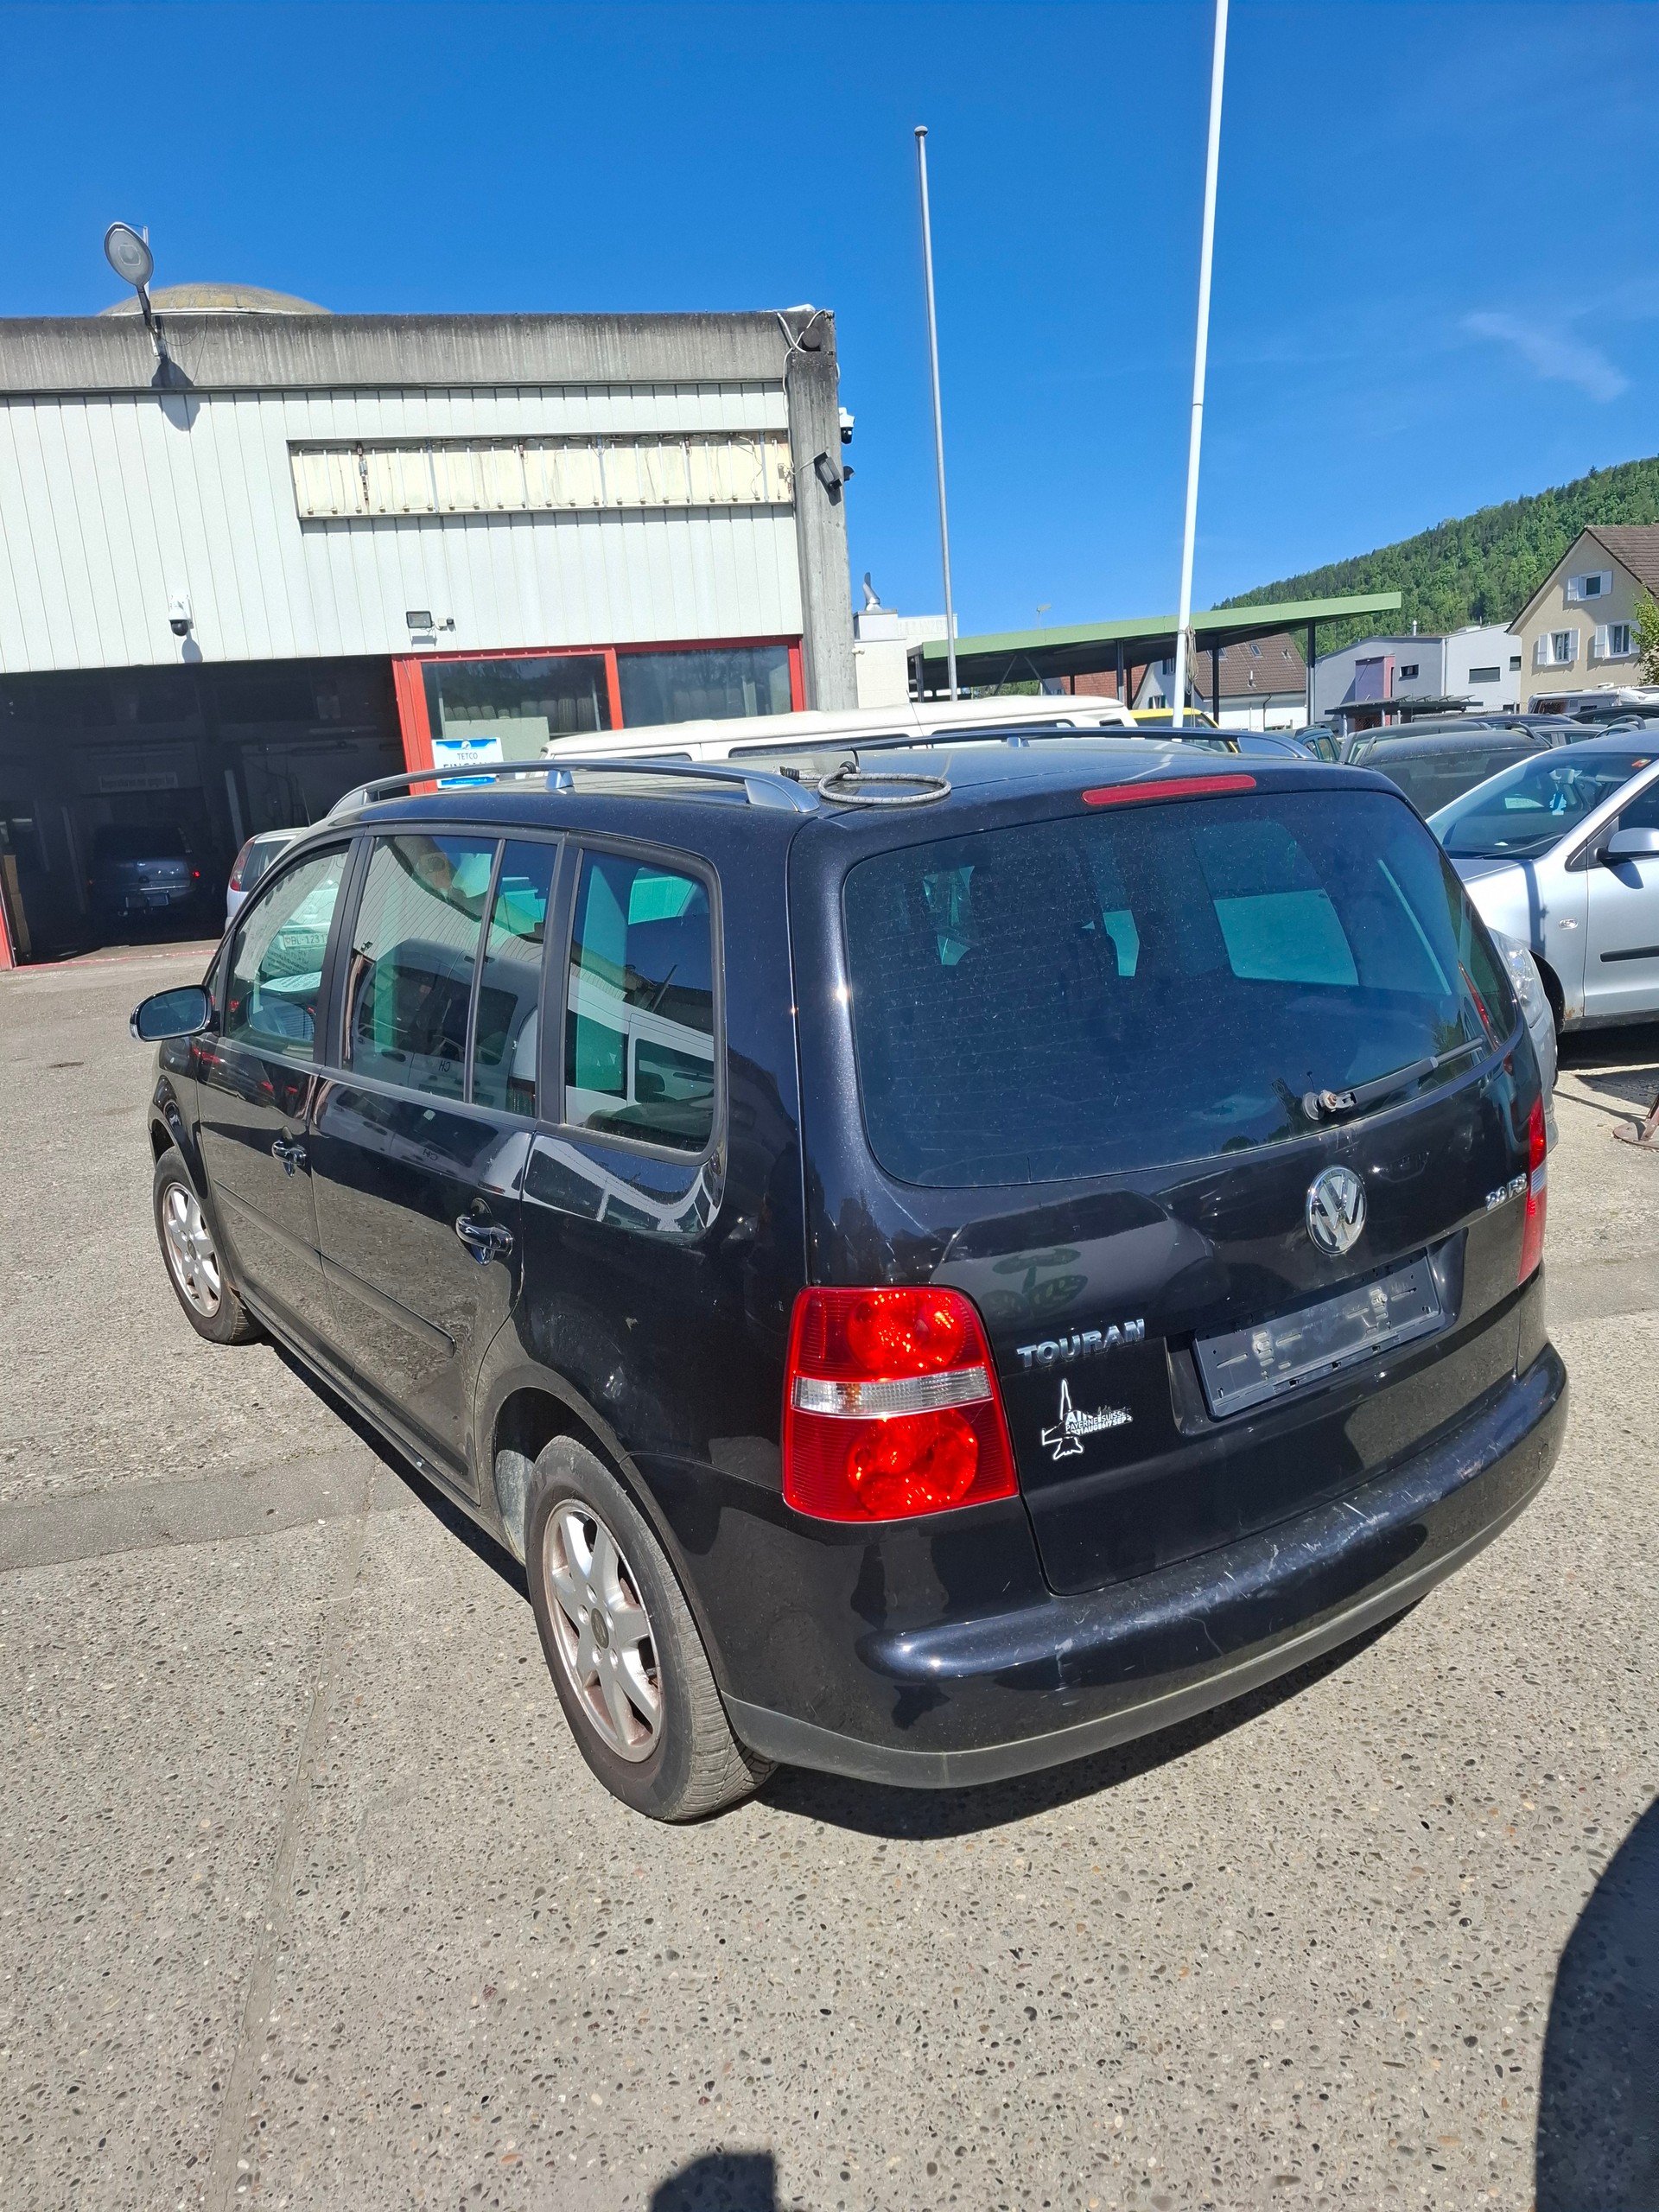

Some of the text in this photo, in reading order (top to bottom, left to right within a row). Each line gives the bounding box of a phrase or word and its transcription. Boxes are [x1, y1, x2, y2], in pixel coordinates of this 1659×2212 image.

[457, 752, 478, 760] TETCO
[1306, 1166, 1366, 1255] VW
[1016, 1319, 1145, 1368] TOURAN
[1065, 1417, 1097, 1433] PAYERNE
